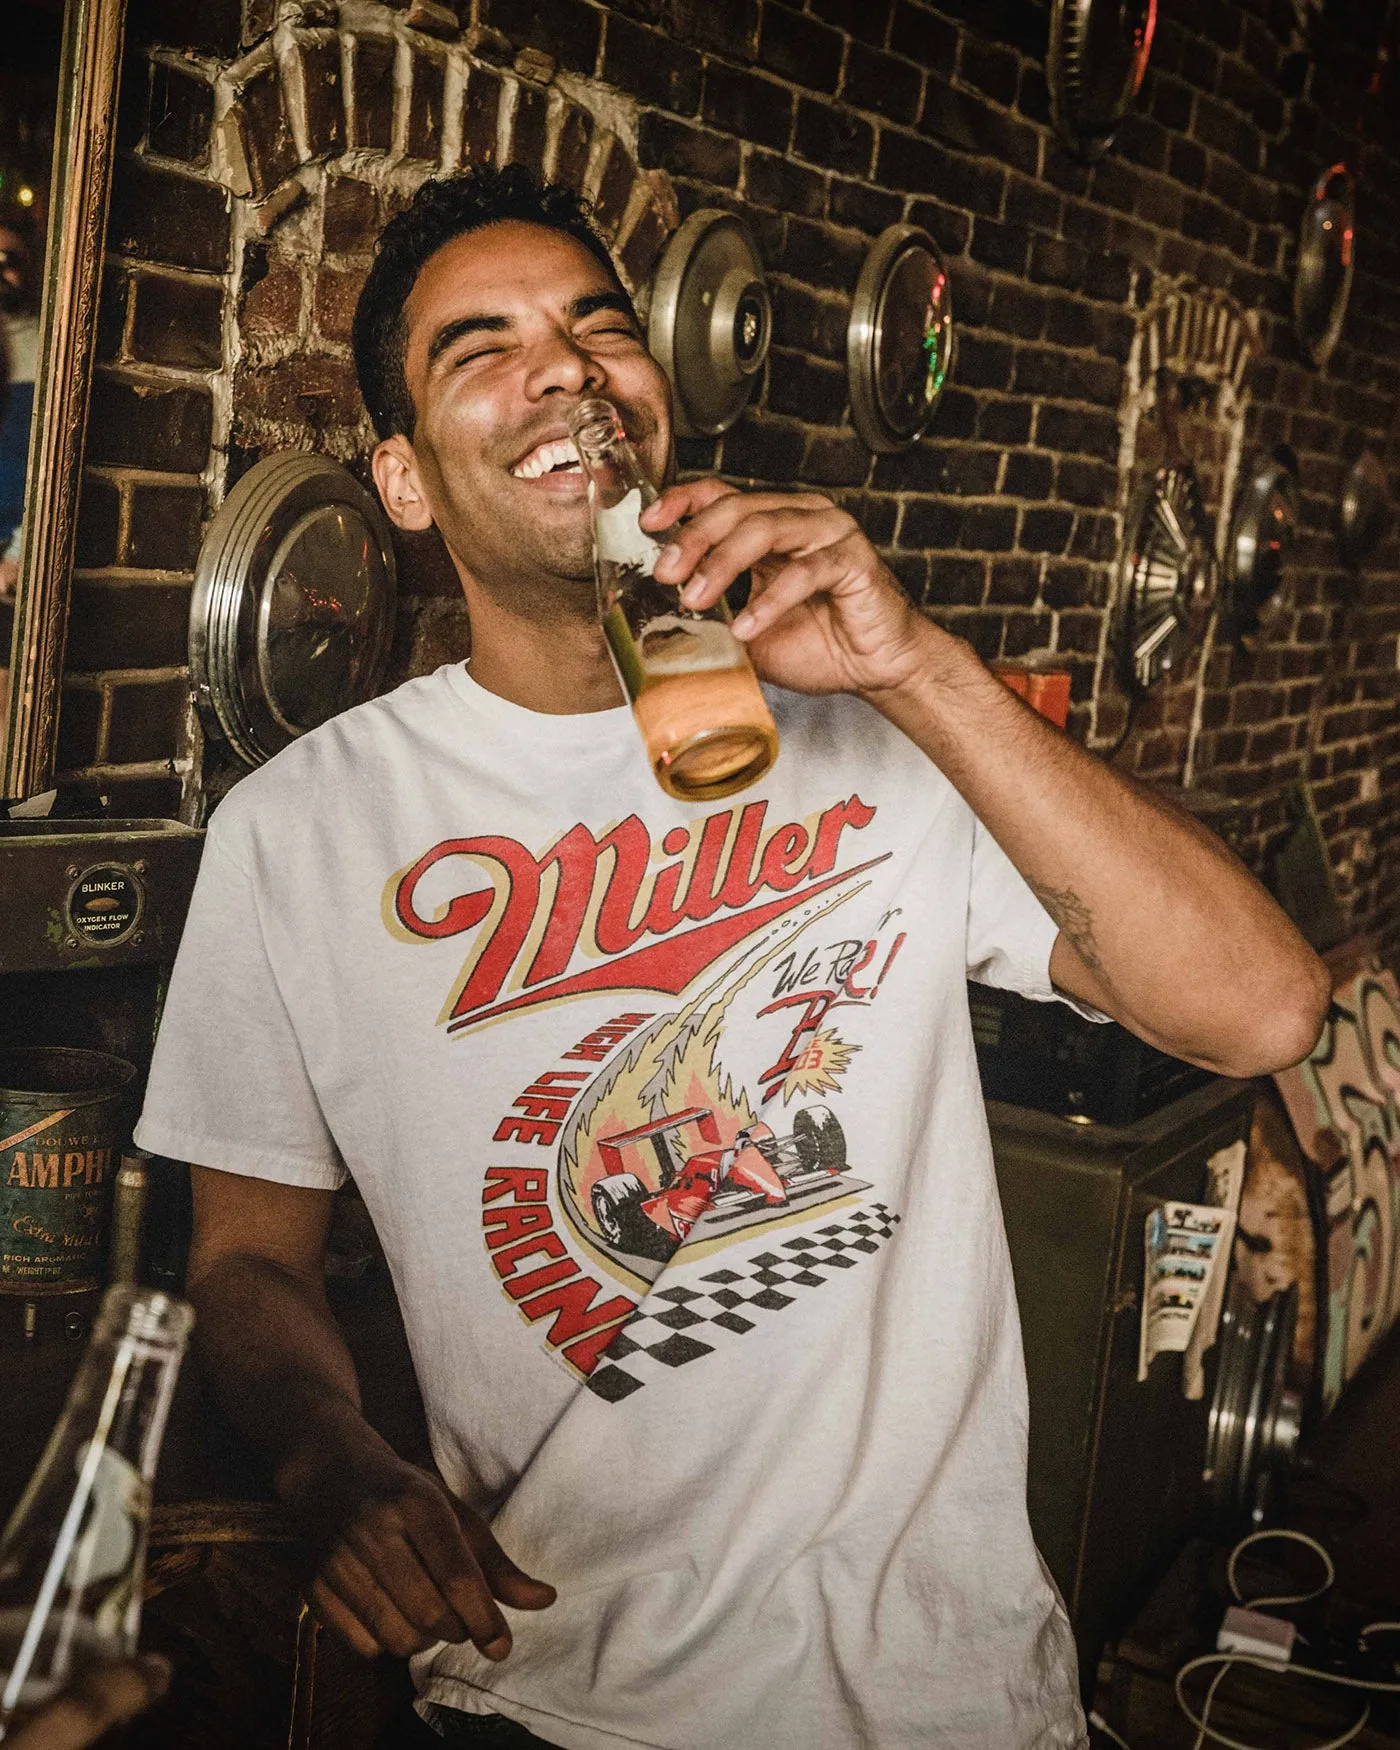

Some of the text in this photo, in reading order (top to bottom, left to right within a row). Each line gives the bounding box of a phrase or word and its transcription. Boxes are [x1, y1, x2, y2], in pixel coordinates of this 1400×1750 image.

[81, 881, 125, 893] BLINKER
[76, 913, 129, 923] OXYGEN FLOW
[386, 793, 878, 1022] Miller
[84, 923, 121, 931] INDICATOR
[772, 946, 821, 998] We
[824, 939, 863, 985] Ra
[560, 1012, 657, 1063] HIGH
[492, 1071, 592, 1147] LIFE
[3, 1254, 31, 1263] RICH
